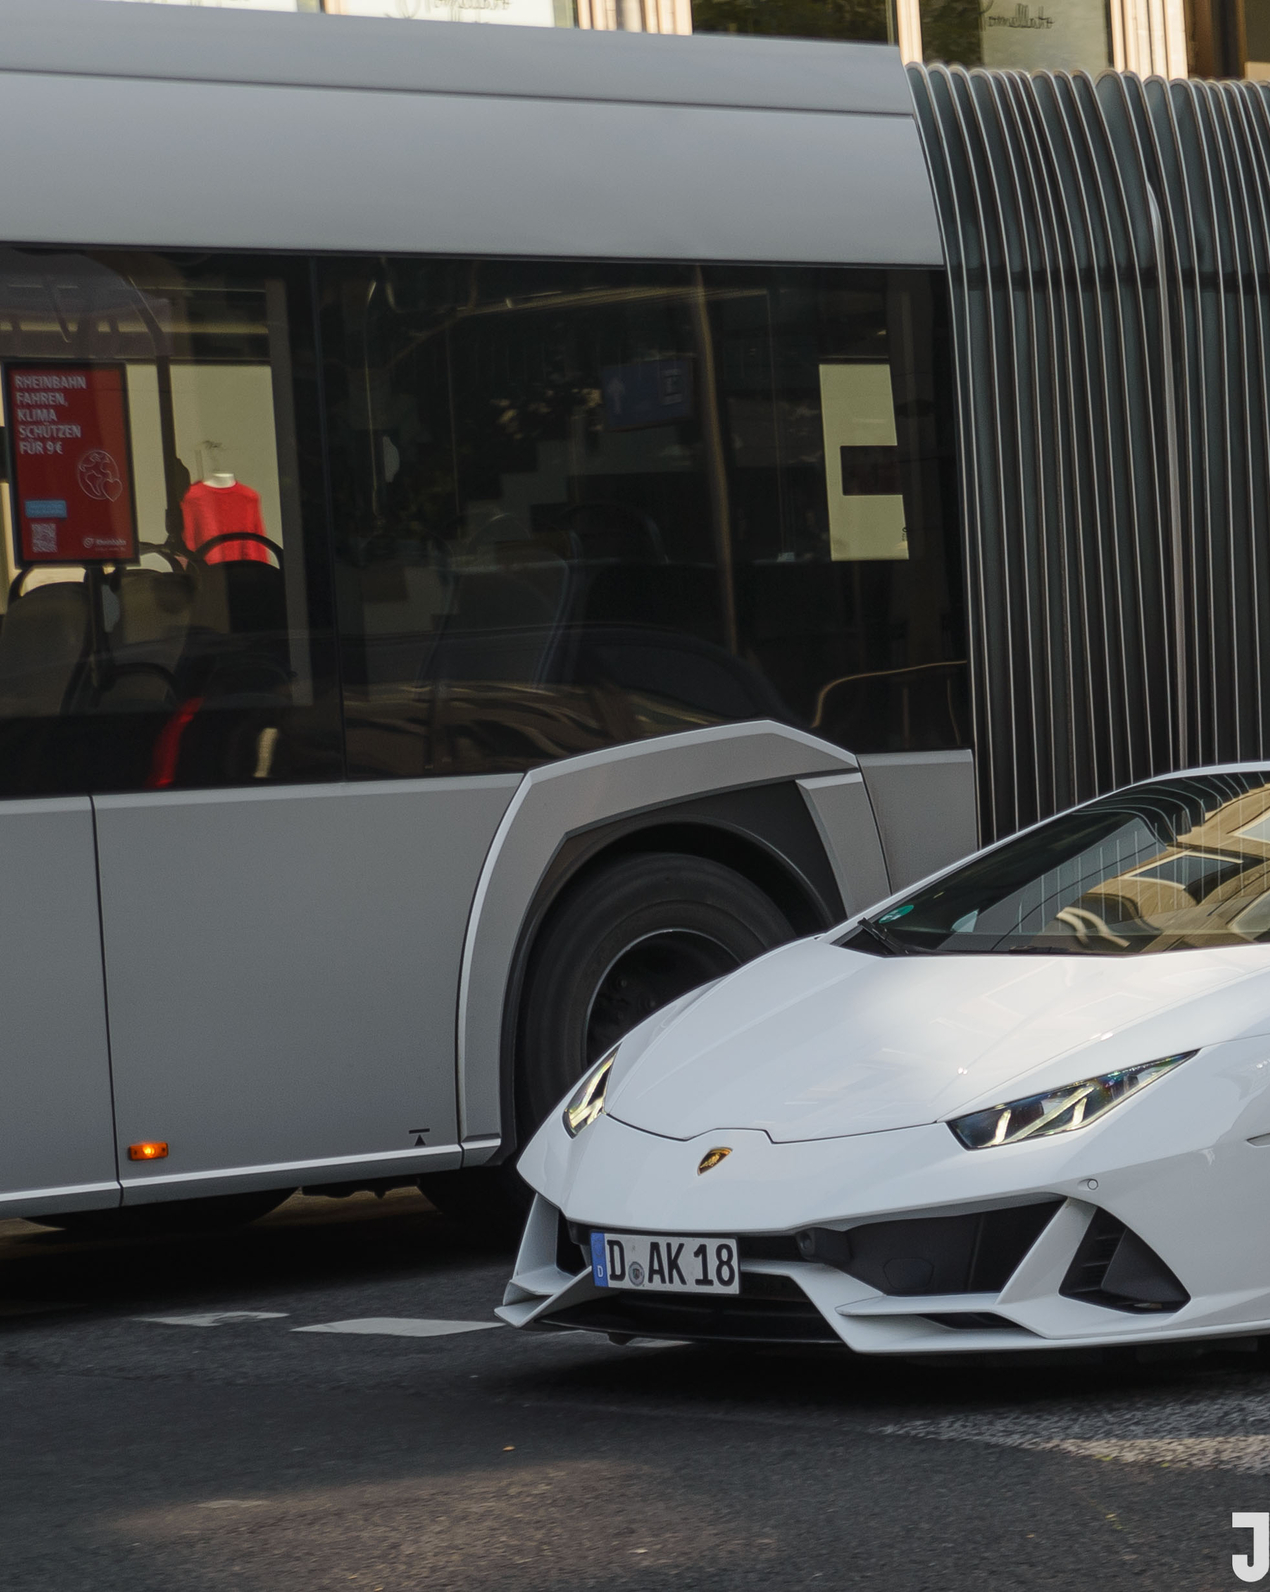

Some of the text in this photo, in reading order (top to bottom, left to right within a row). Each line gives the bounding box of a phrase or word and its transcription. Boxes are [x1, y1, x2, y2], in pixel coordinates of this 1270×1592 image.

[14, 375, 87, 389] RHEINBAHN
[16, 391, 69, 407] FAHREN,
[17, 408, 58, 422] KLIMA
[19, 421, 82, 438] SCHÜTZEN
[20, 439, 44, 455] FÜR
[606, 1239, 736, 1287] D AK 18
